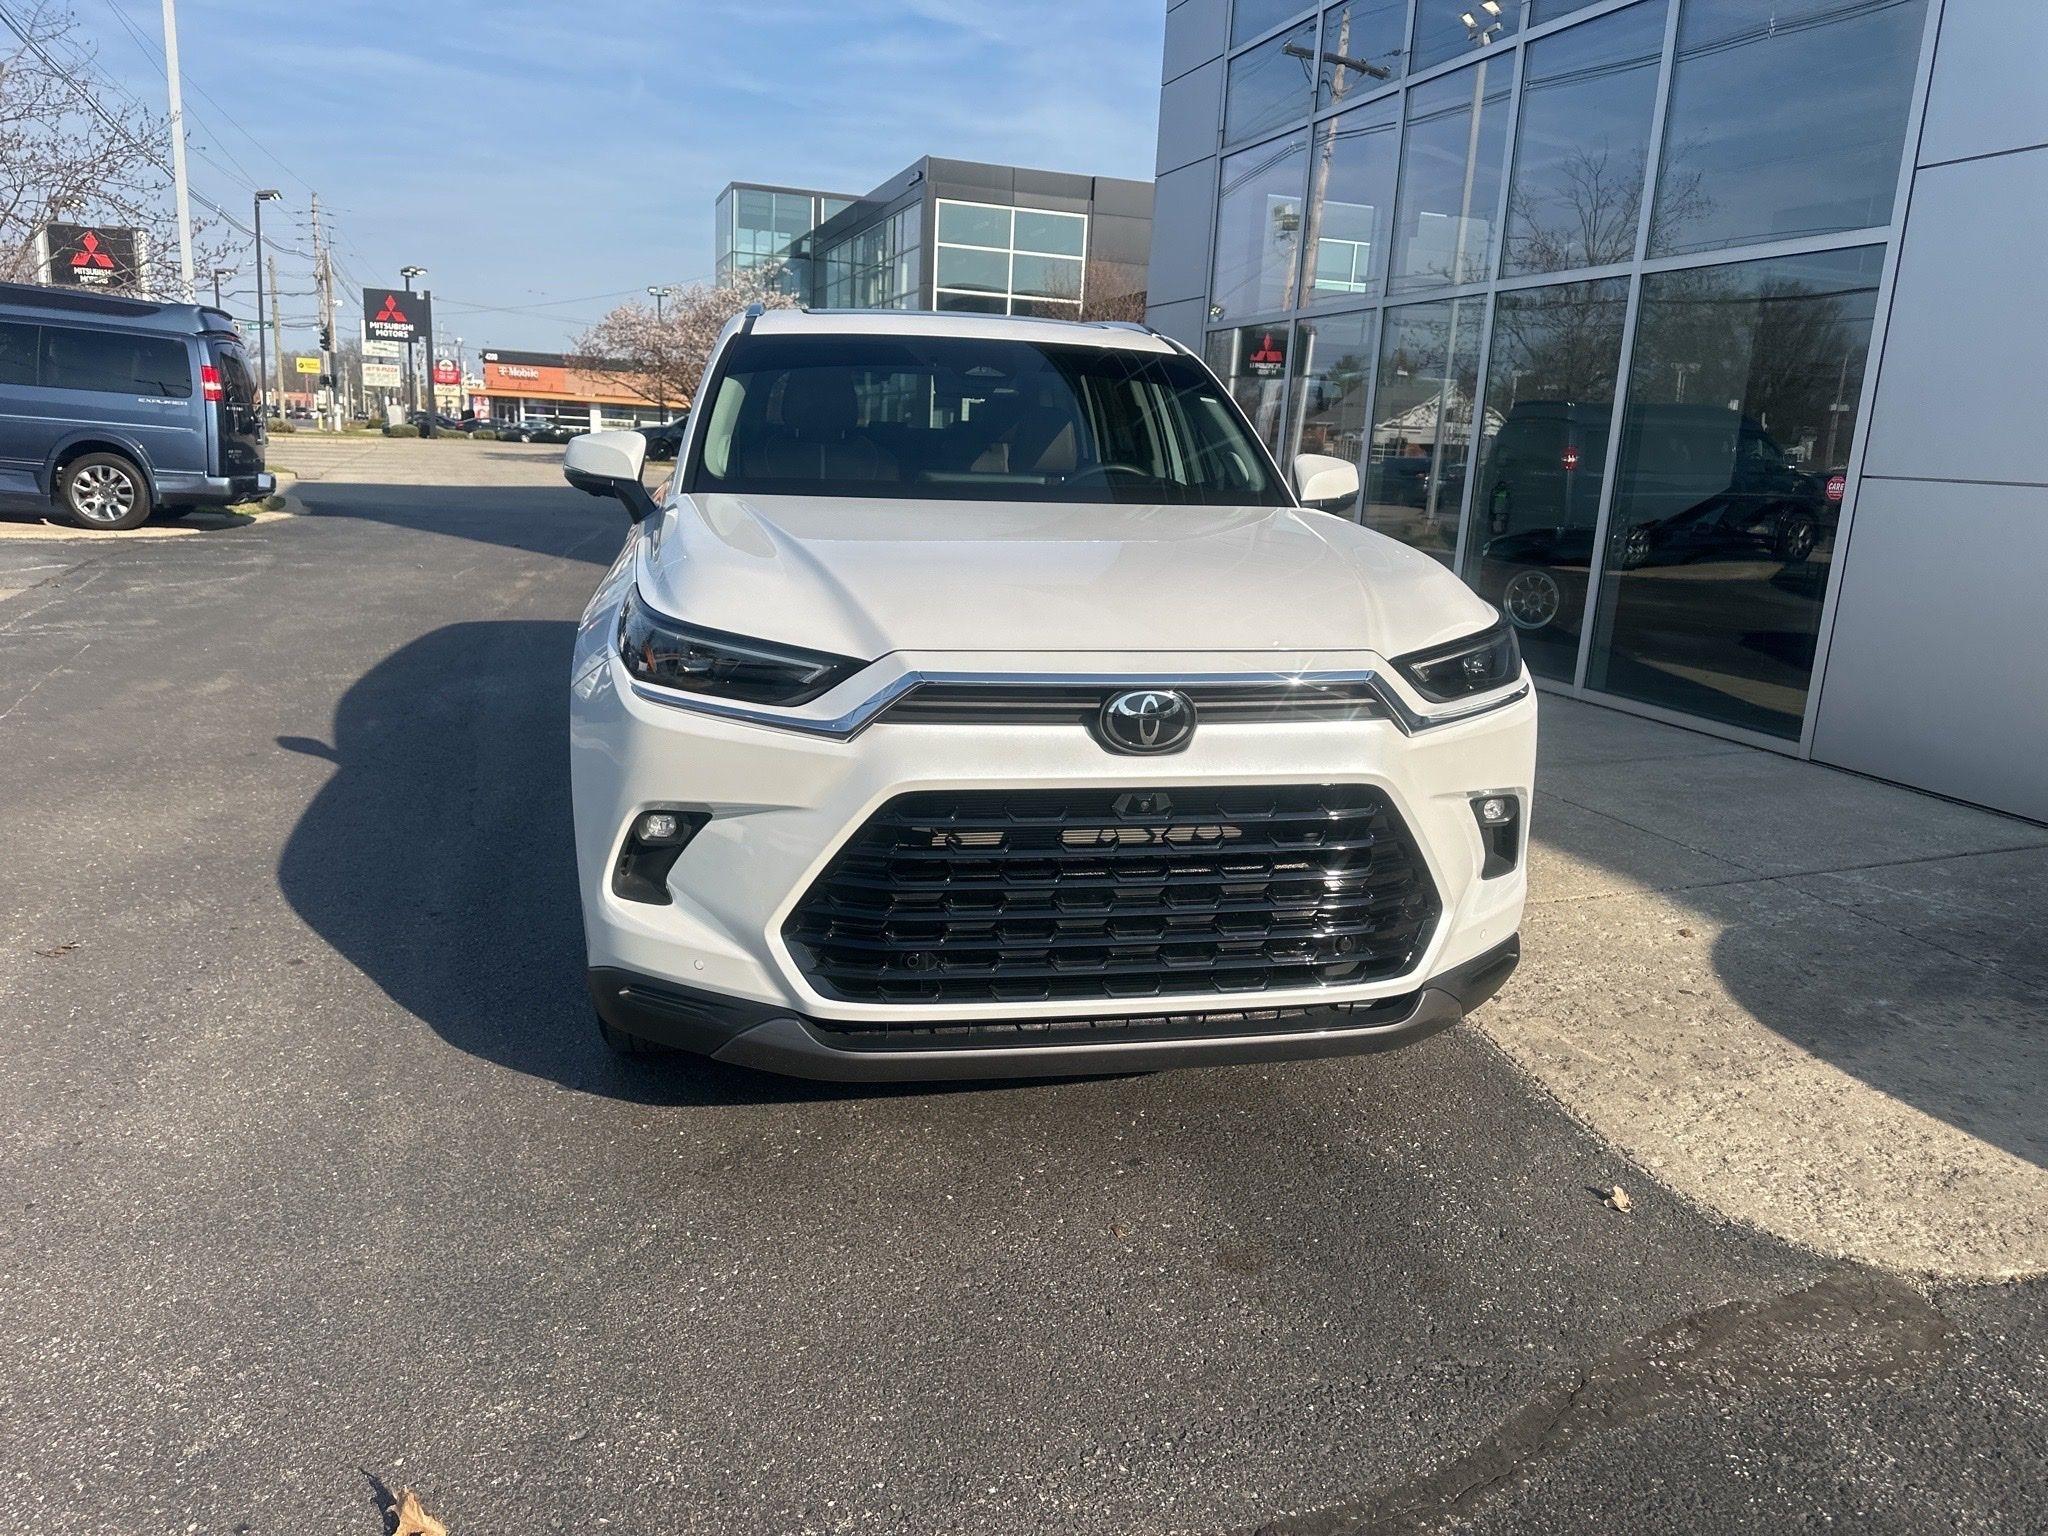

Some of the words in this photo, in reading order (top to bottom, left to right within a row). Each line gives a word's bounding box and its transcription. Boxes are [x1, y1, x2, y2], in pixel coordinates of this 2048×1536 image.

[369, 321, 414, 331] MITSUBISHI
[375, 329, 409, 338] MOTORS
[1828, 482, 1845, 491] CARE
